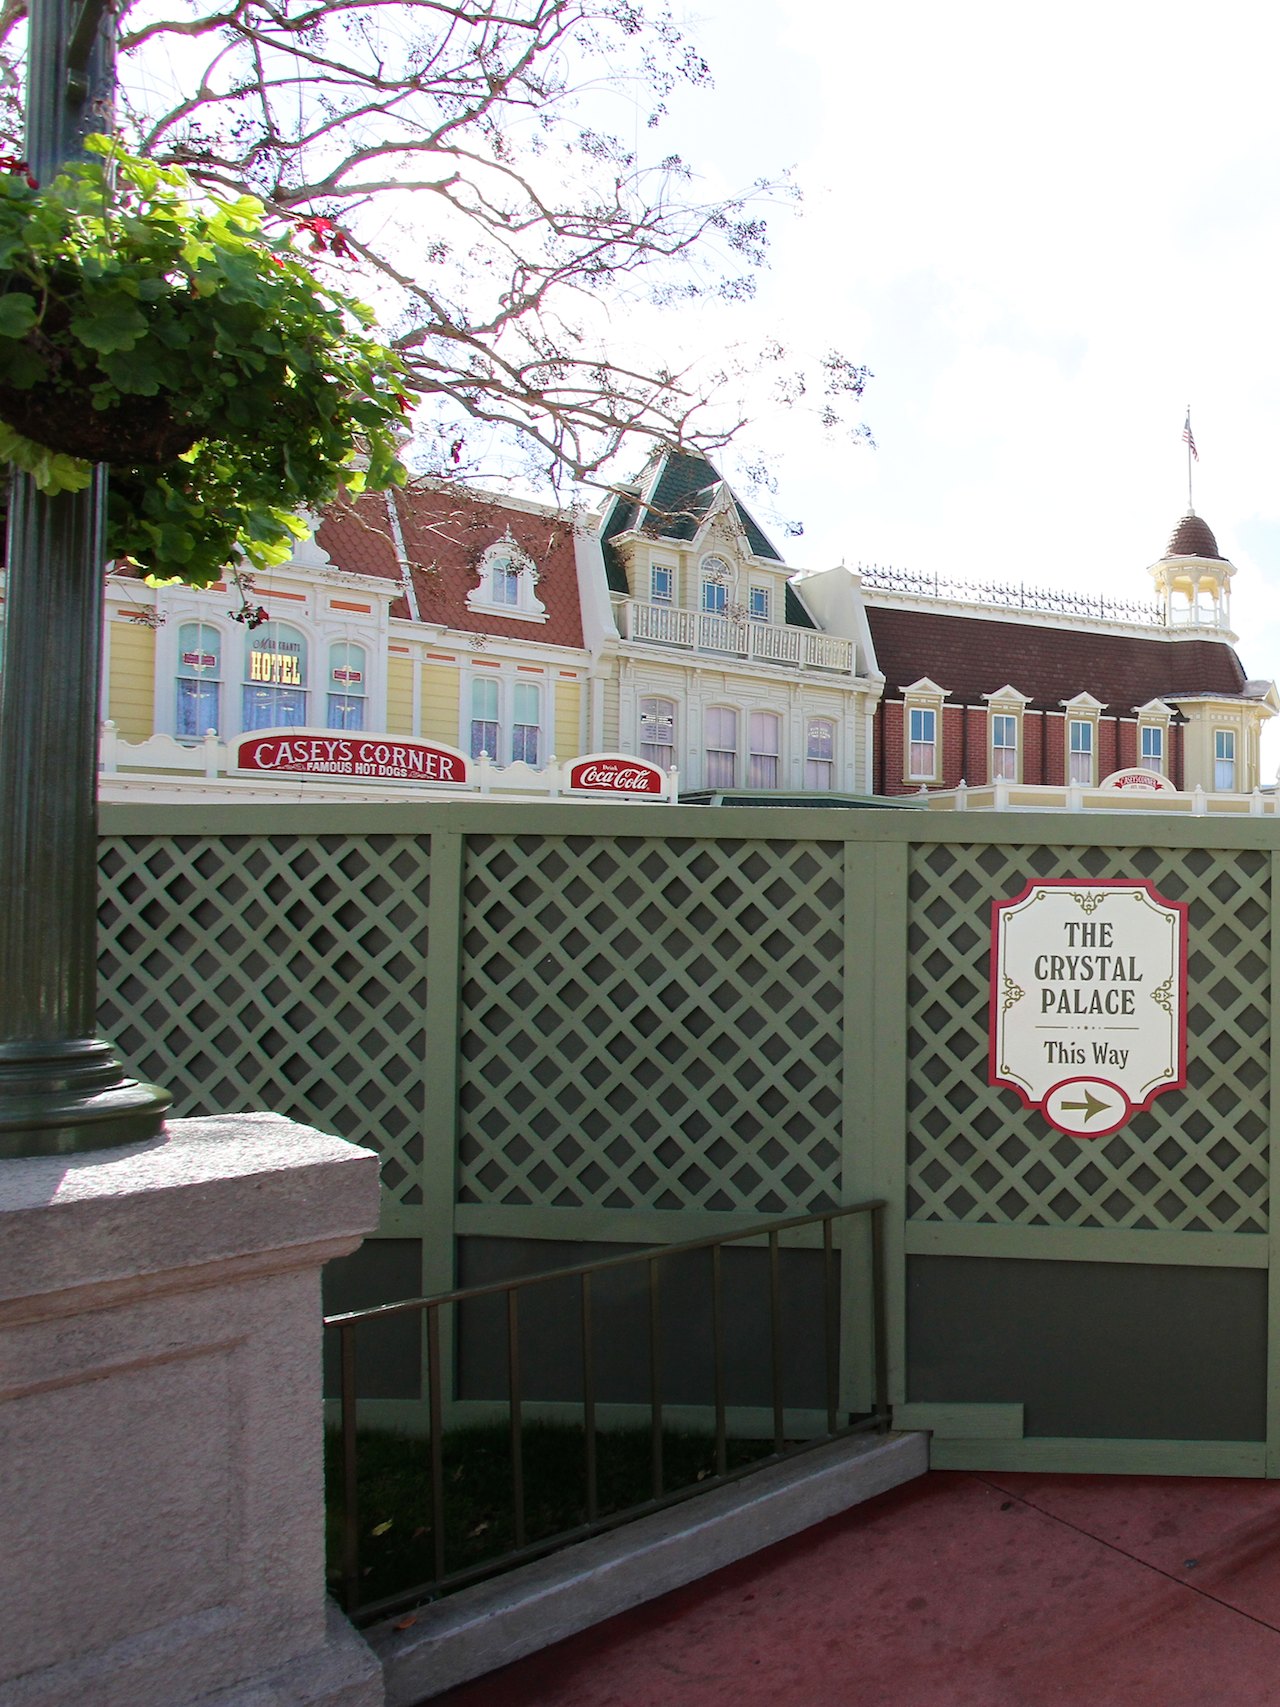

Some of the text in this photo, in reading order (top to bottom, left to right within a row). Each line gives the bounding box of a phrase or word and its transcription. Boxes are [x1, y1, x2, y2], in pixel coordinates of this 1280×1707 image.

[250, 650, 301, 685] HOTEL
[253, 739, 454, 781] CASEY'S CORNER
[306, 762, 408, 778] FAMOUS HOT DOGS
[579, 765, 651, 790] Coca-Cola
[1064, 922, 1114, 948] THE
[1034, 955, 1143, 982] CRYSTAL
[1041, 988, 1135, 1016] PALACE
[1043, 1040, 1130, 1070] This Way
